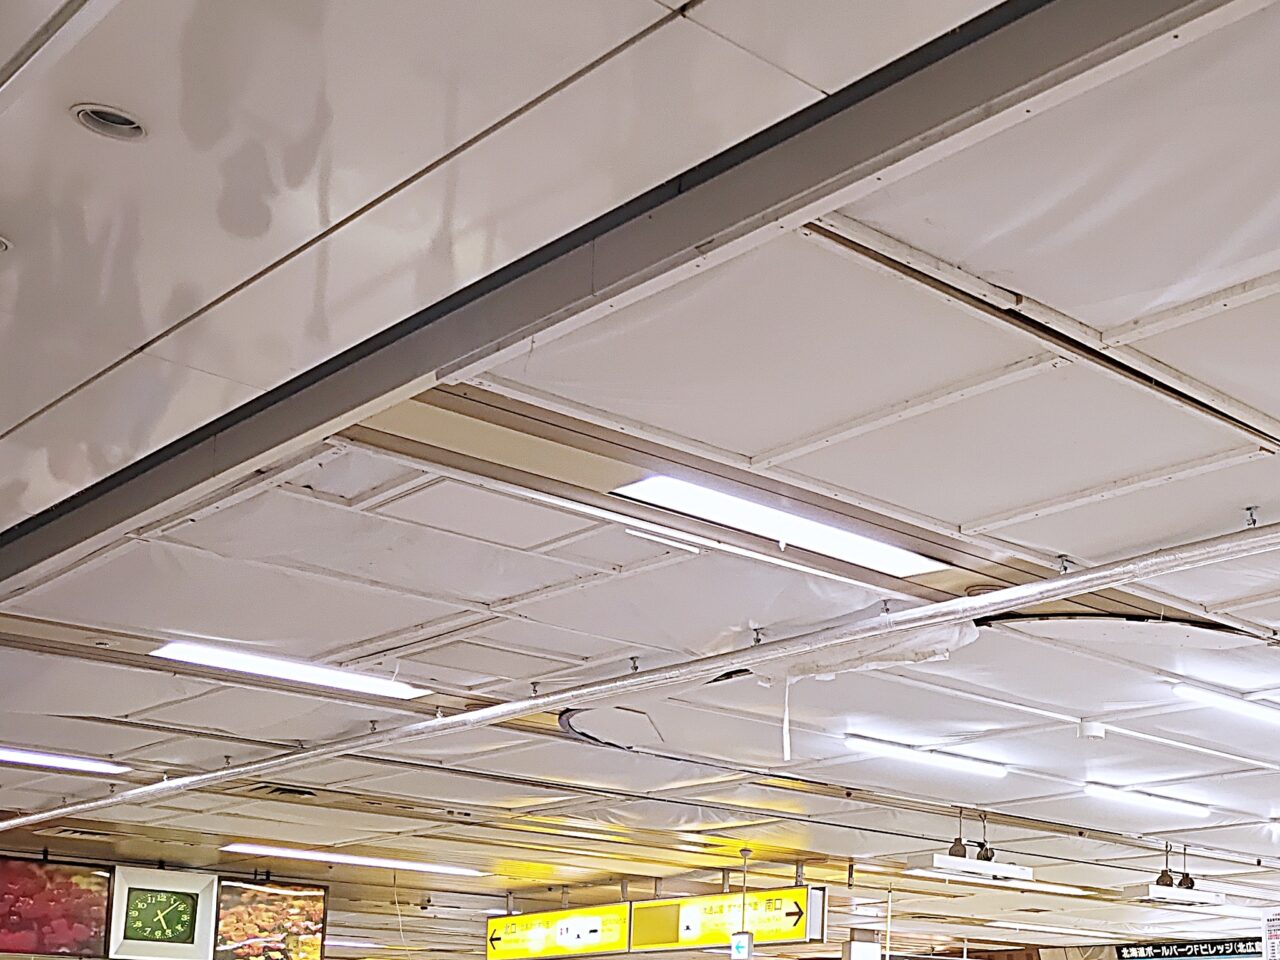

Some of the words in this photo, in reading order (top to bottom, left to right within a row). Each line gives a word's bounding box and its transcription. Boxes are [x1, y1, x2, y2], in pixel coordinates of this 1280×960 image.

[147, 895, 156, 903] 11
[157, 894, 167, 902] 12
[765, 898, 782, 912] 南口
